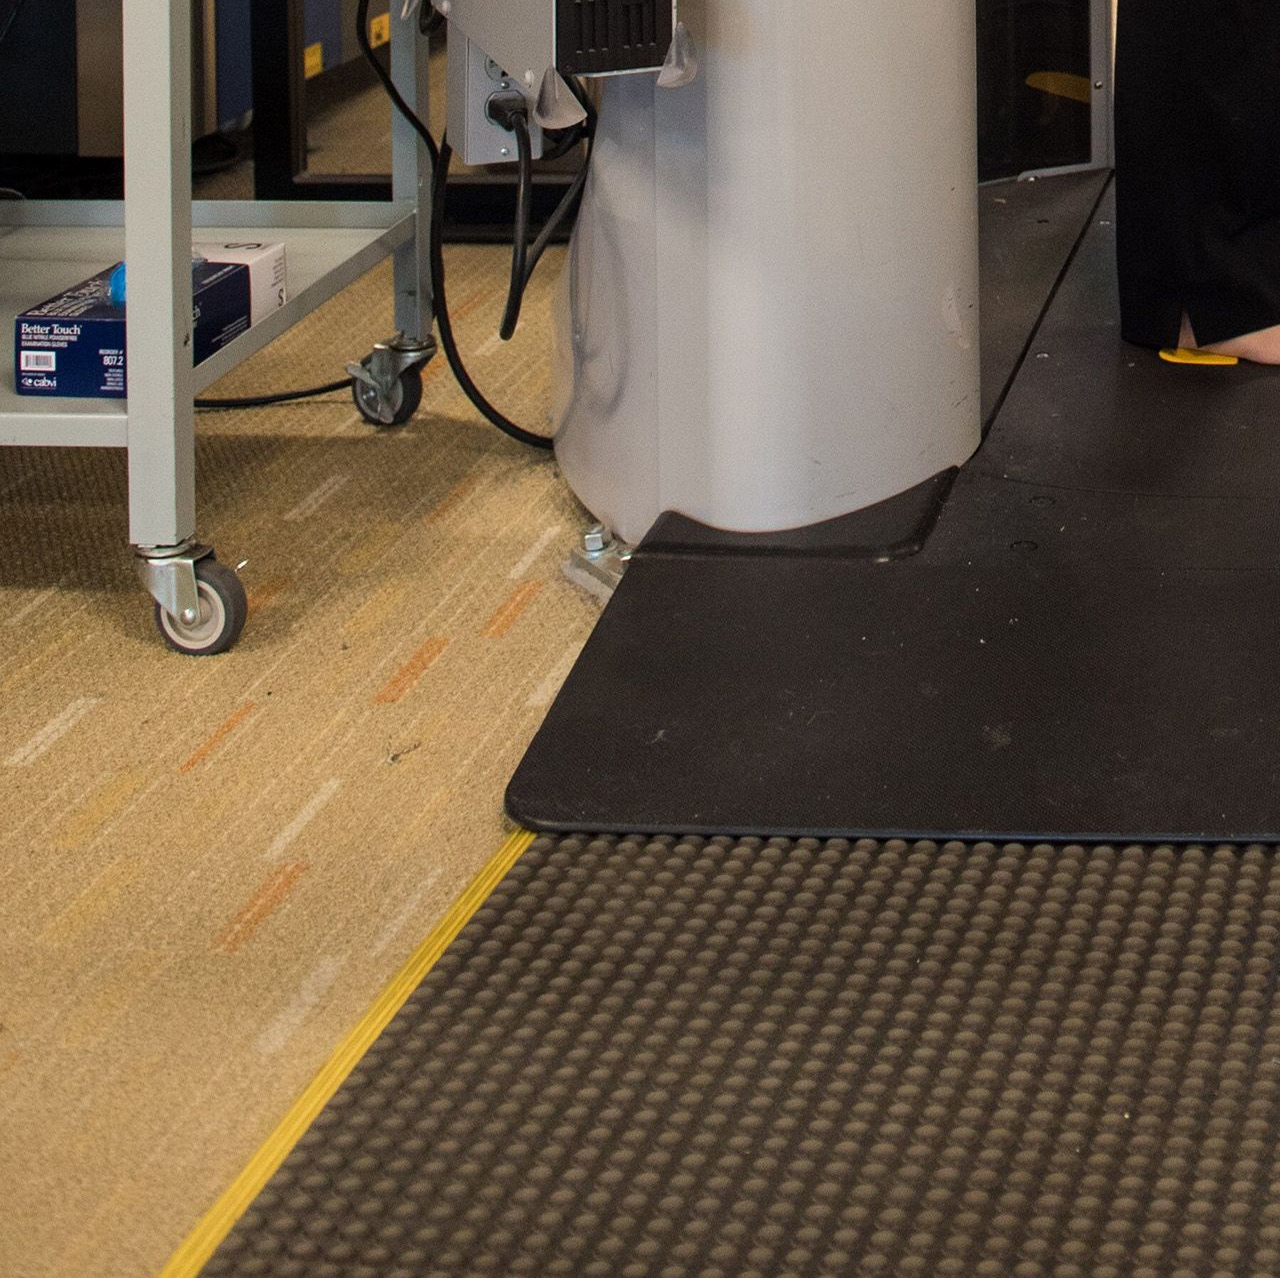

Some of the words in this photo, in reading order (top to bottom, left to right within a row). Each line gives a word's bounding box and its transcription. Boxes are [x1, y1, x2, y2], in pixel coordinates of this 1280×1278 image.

[278, 288, 285, 307] S
[21, 323, 50, 334] Better
[52, 324, 81, 335] Touch
[33, 376, 57, 387] cabvi
